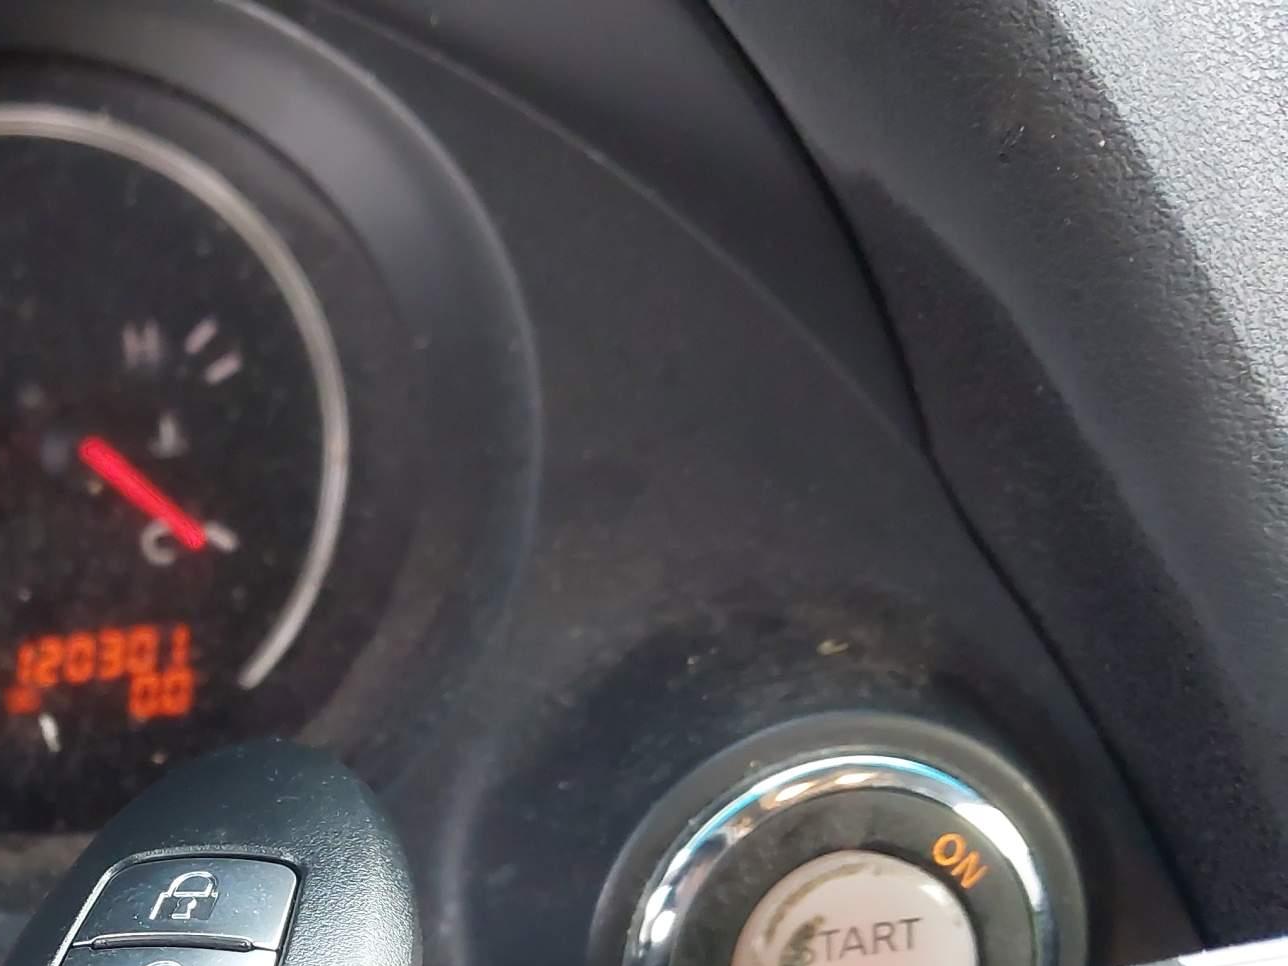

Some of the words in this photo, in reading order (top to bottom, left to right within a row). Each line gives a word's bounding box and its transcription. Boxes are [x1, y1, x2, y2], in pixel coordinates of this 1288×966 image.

[121, 320, 163, 367] H
[16, 623, 191, 687] 120301
[931, 832, 988, 889] ON
